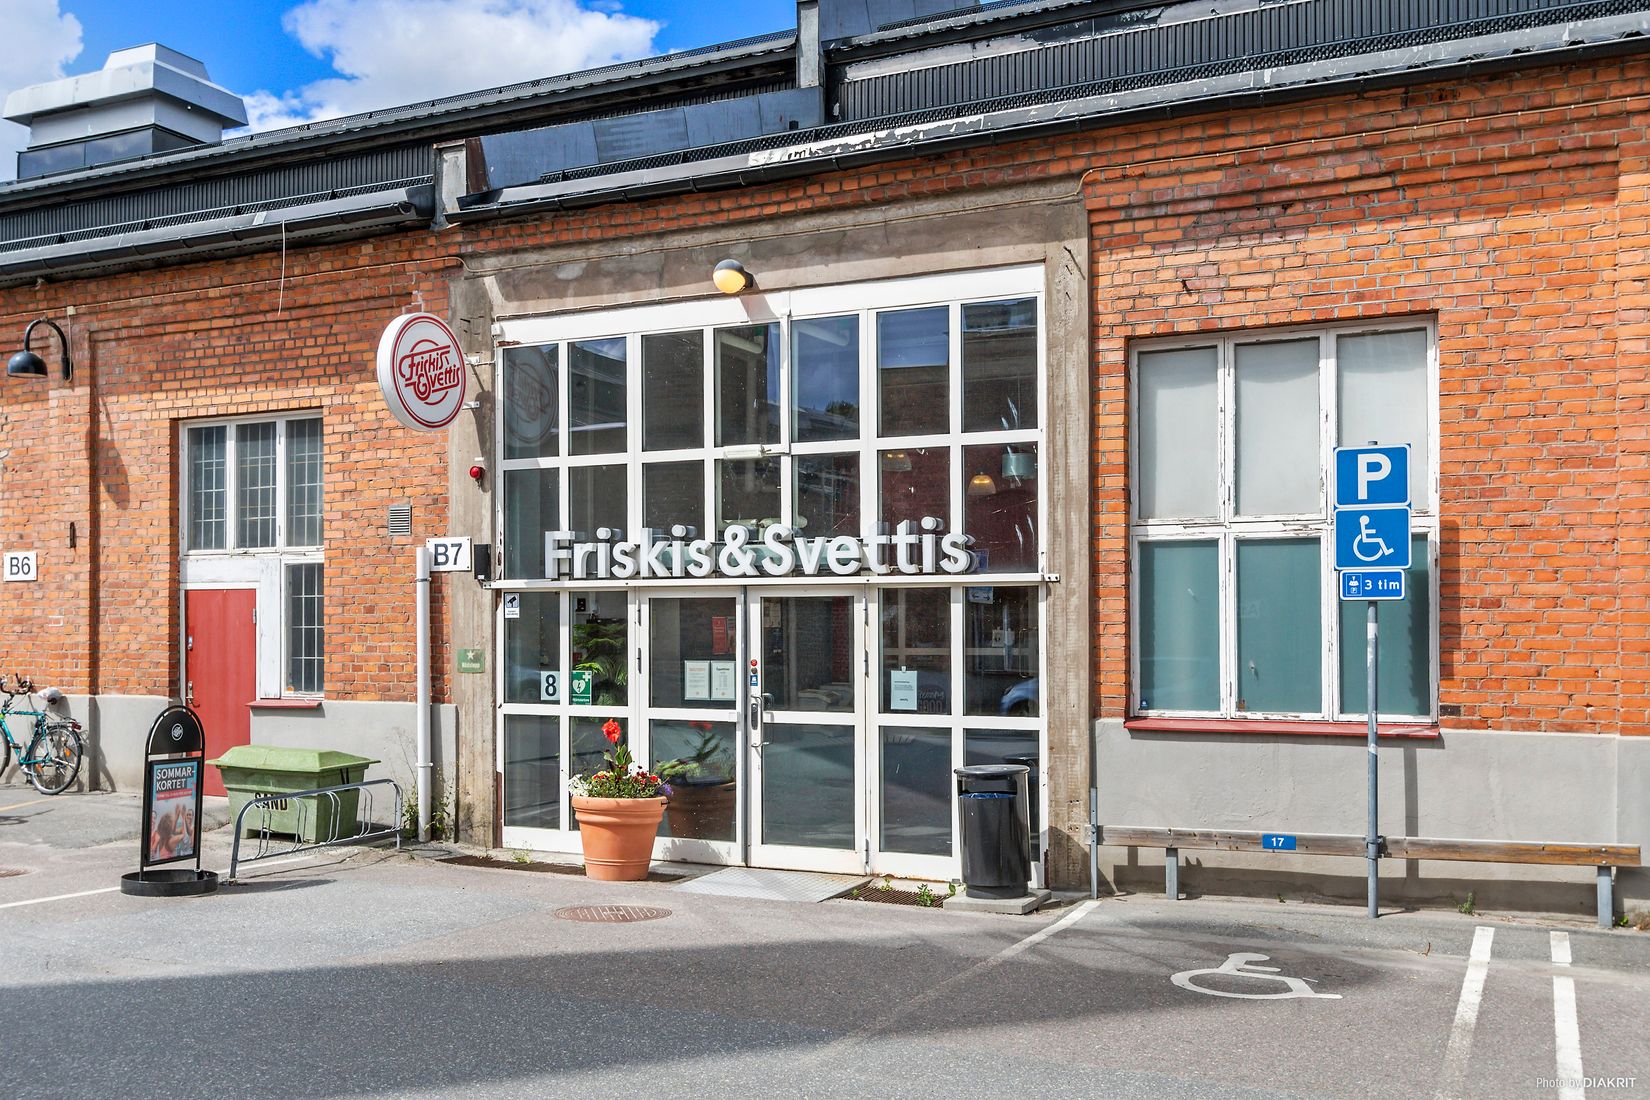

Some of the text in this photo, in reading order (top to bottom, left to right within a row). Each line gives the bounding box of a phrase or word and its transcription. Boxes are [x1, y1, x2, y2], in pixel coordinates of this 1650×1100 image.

[399, 345, 450, 382] Friskis
[1357, 453, 1392, 500] P
[433, 543, 462, 566] B7
[545, 516, 972, 578] Friskis&Svettis
[10, 556, 31, 576] B6
[1364, 579, 1400, 590] 3 tim
[545, 674, 557, 697] 8
[156, 767, 195, 779] SOMMAR-
[156, 779, 186, 791] KORTET
[1271, 837, 1284, 847] 17
